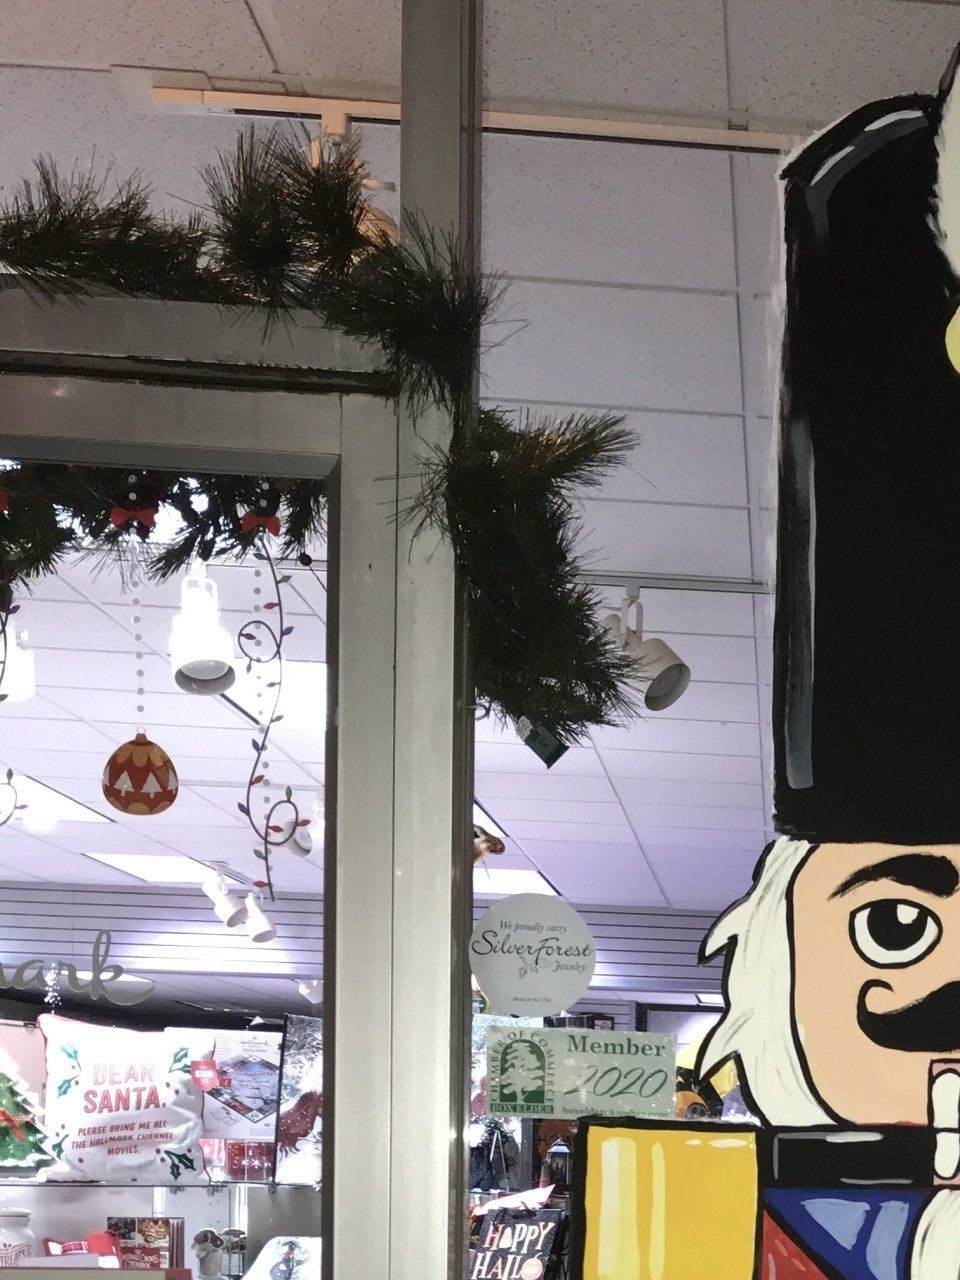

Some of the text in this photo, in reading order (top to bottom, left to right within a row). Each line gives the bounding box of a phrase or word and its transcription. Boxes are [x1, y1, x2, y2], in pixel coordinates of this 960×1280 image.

[567, 1034, 666, 1057] Member
[93, 1060, 154, 1086] DEAR
[490, 1030, 556, 1103] CHAMBER OF COMMERCE
[563, 1065, 669, 1099] 2020
[492, 1103, 552, 1114] BOX ELDER
[78, 1120, 167, 1136] PLEASE BRING ME ALL
[71, 1132, 173, 1150] THE HALLMARK CHANNEL
